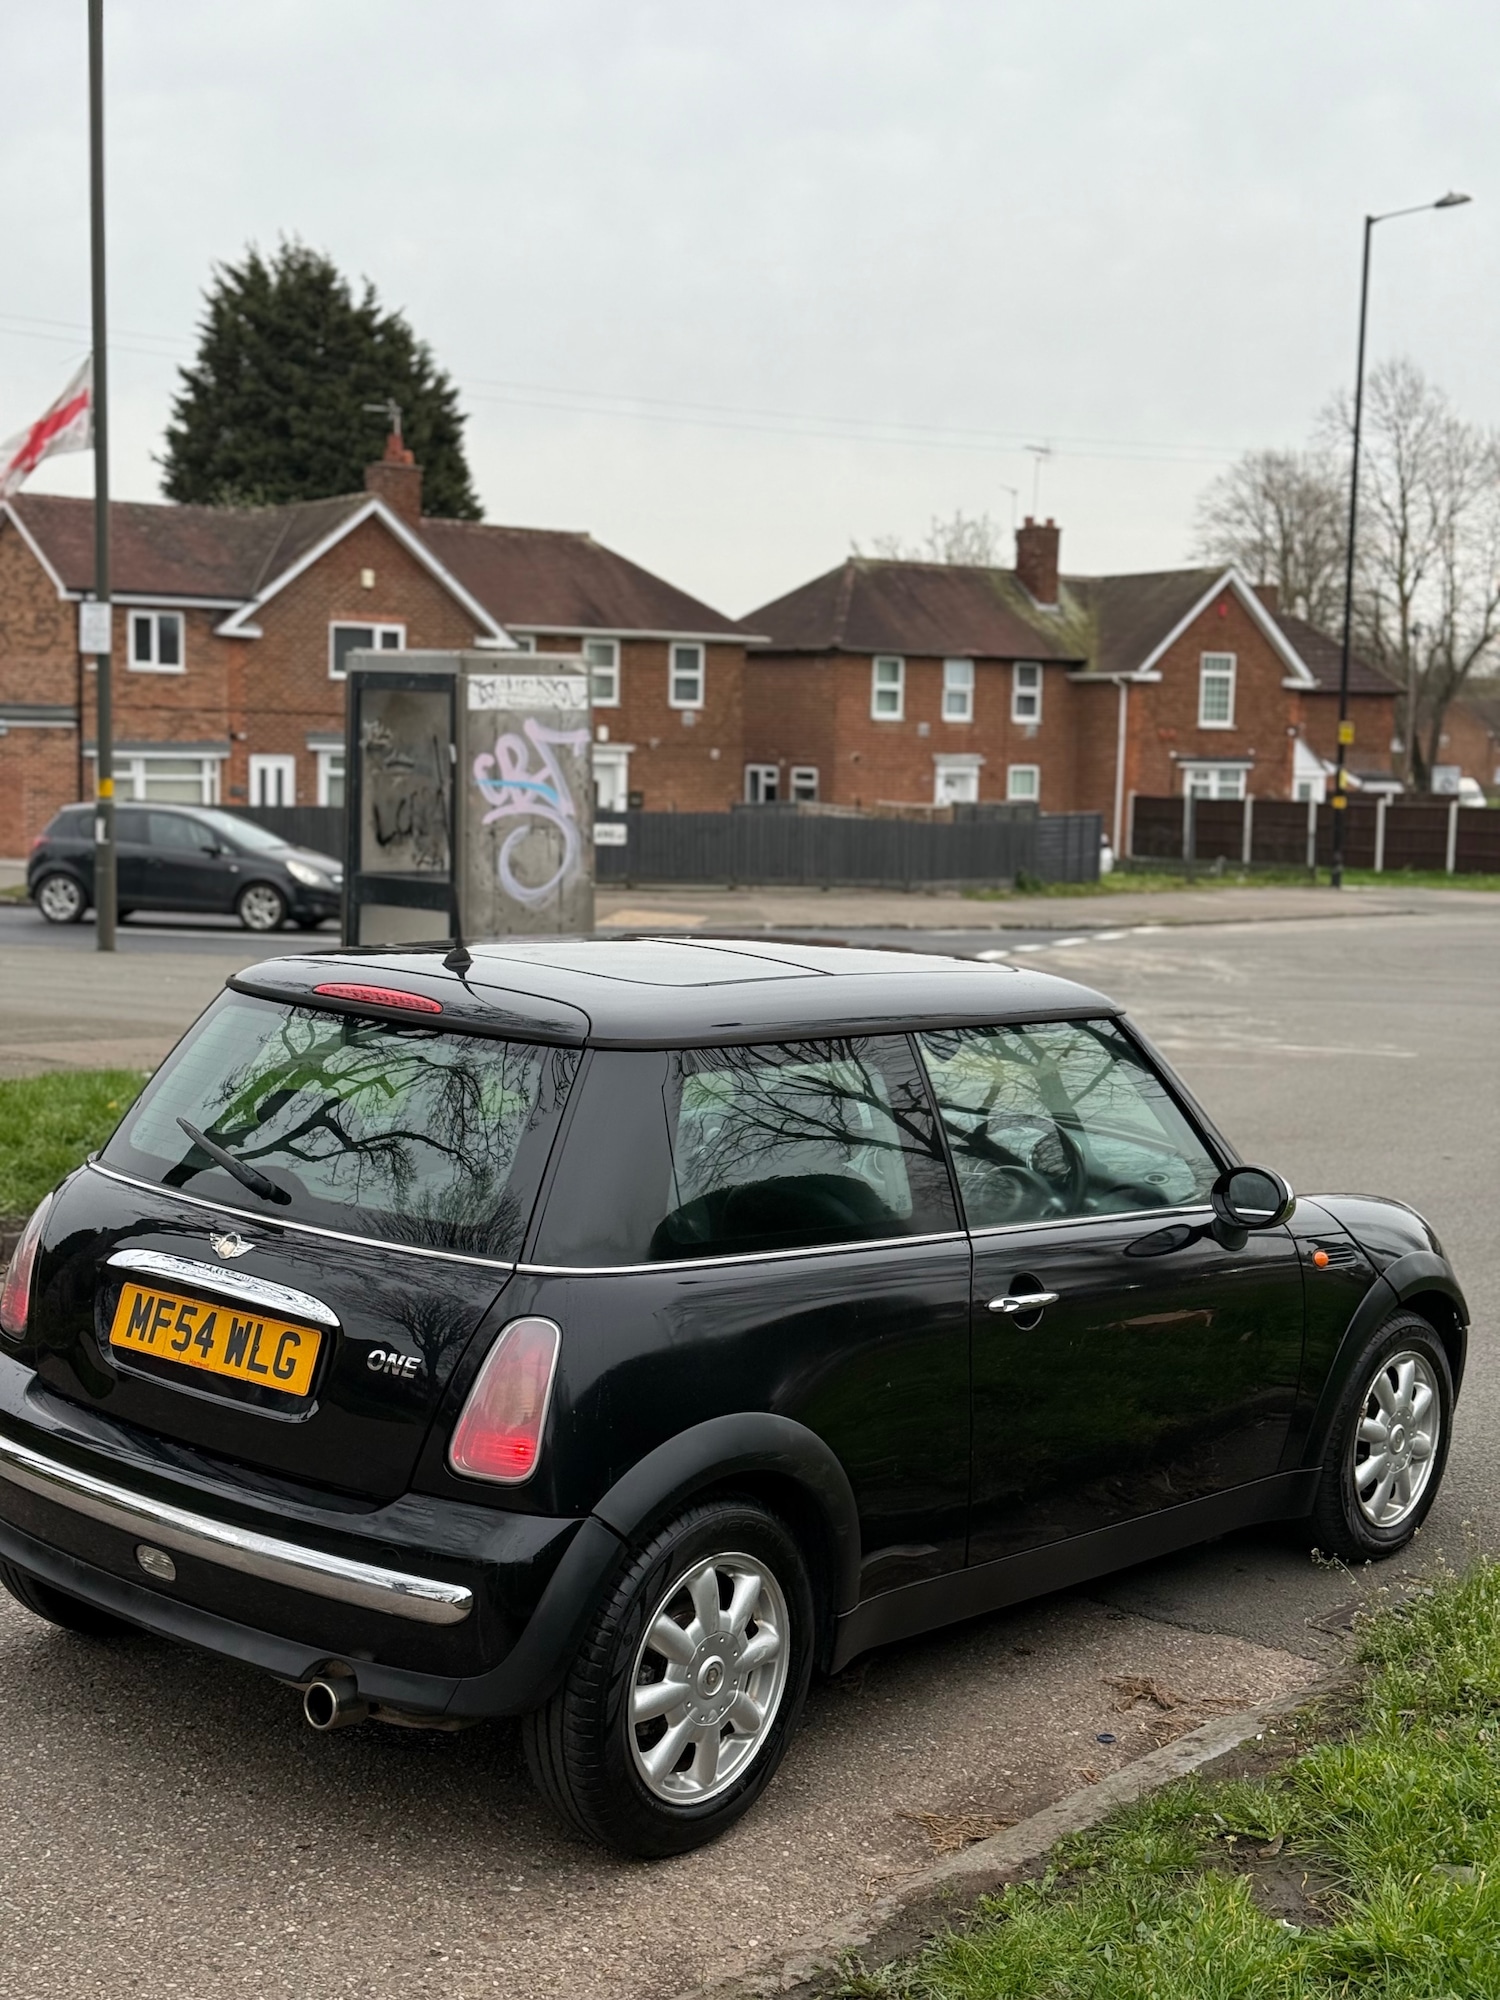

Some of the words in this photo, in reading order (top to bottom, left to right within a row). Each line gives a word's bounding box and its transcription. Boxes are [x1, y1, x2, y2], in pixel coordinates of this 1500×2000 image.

[126, 1293, 217, 1358] MF54
[224, 1317, 301, 1380] WLG
[366, 1349, 422, 1379] ONE
